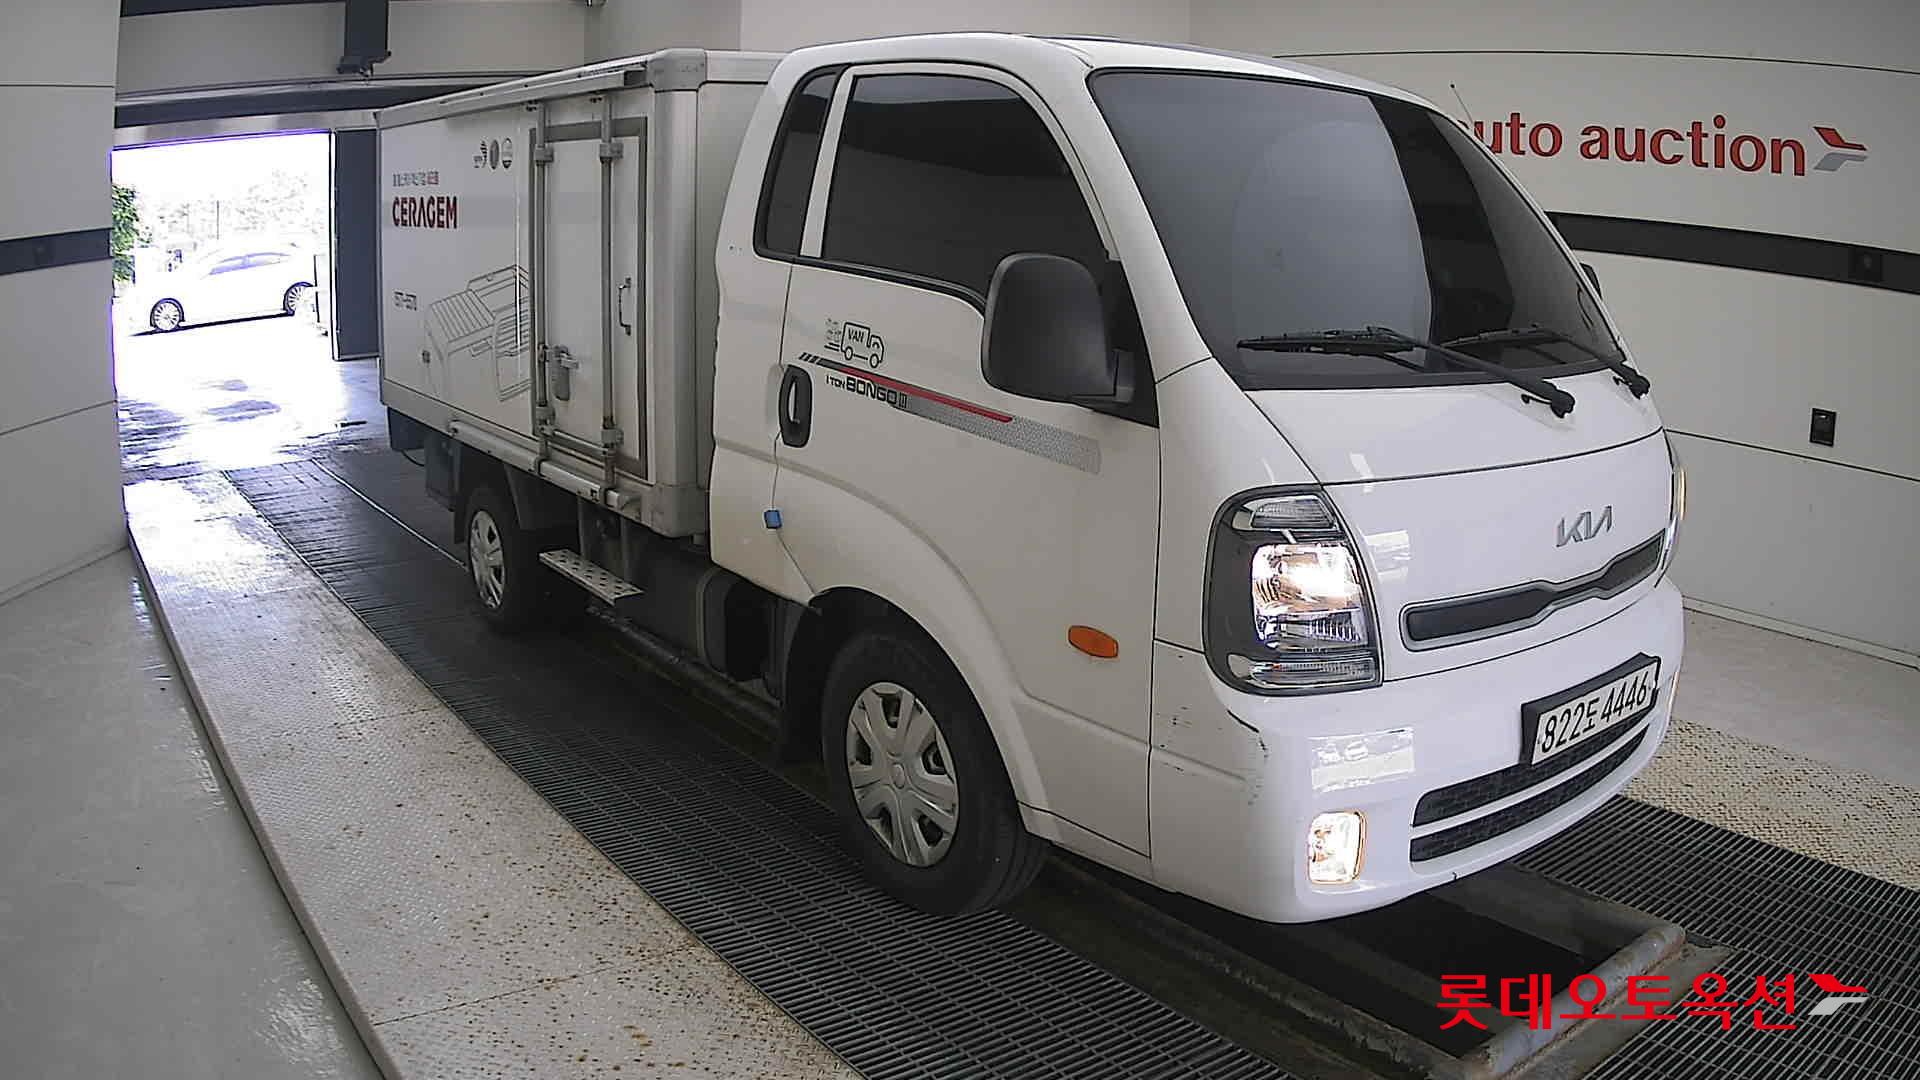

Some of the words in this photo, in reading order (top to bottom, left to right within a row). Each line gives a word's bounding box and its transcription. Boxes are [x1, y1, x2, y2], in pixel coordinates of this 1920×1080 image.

[1457, 112, 1563, 157] uto
[1579, 114, 1806, 177] auction
[392, 195, 458, 229] CERAGEM
[847, 328, 866, 344] VAN
[846, 376, 898, 405] BONGO
[1555, 505, 1613, 548] KIA
